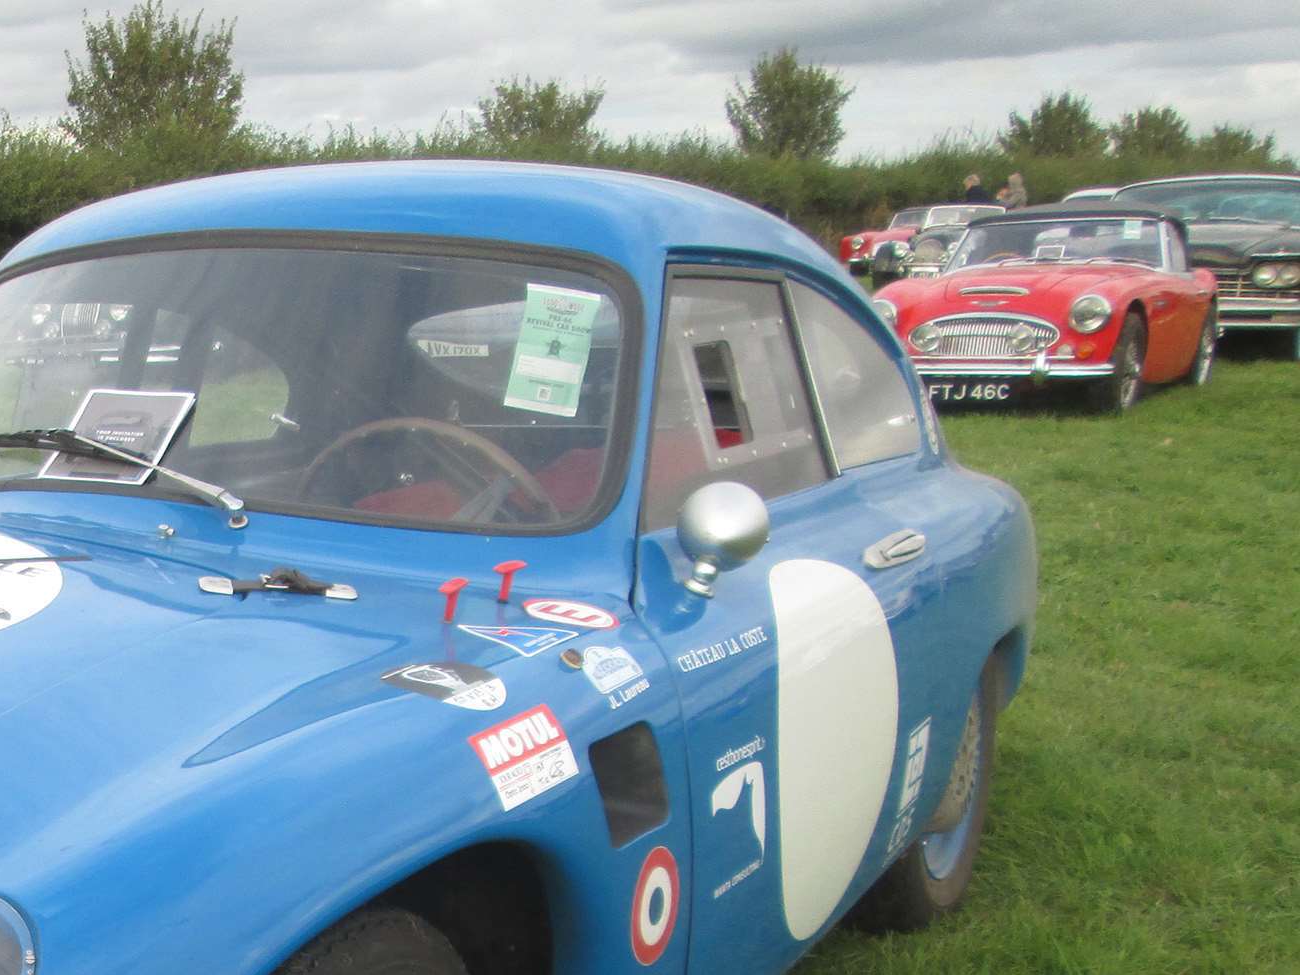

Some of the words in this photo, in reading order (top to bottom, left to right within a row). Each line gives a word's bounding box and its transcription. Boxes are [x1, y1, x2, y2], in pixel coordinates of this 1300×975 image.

[928, 384, 967, 400] FTJ
[971, 384, 1010, 400] 46C
[677, 649, 726, 673] CHÂTEAU
[724, 637, 742, 656] LA
[740, 626, 768, 649] COSTE
[478, 711, 561, 770] MOTUL
